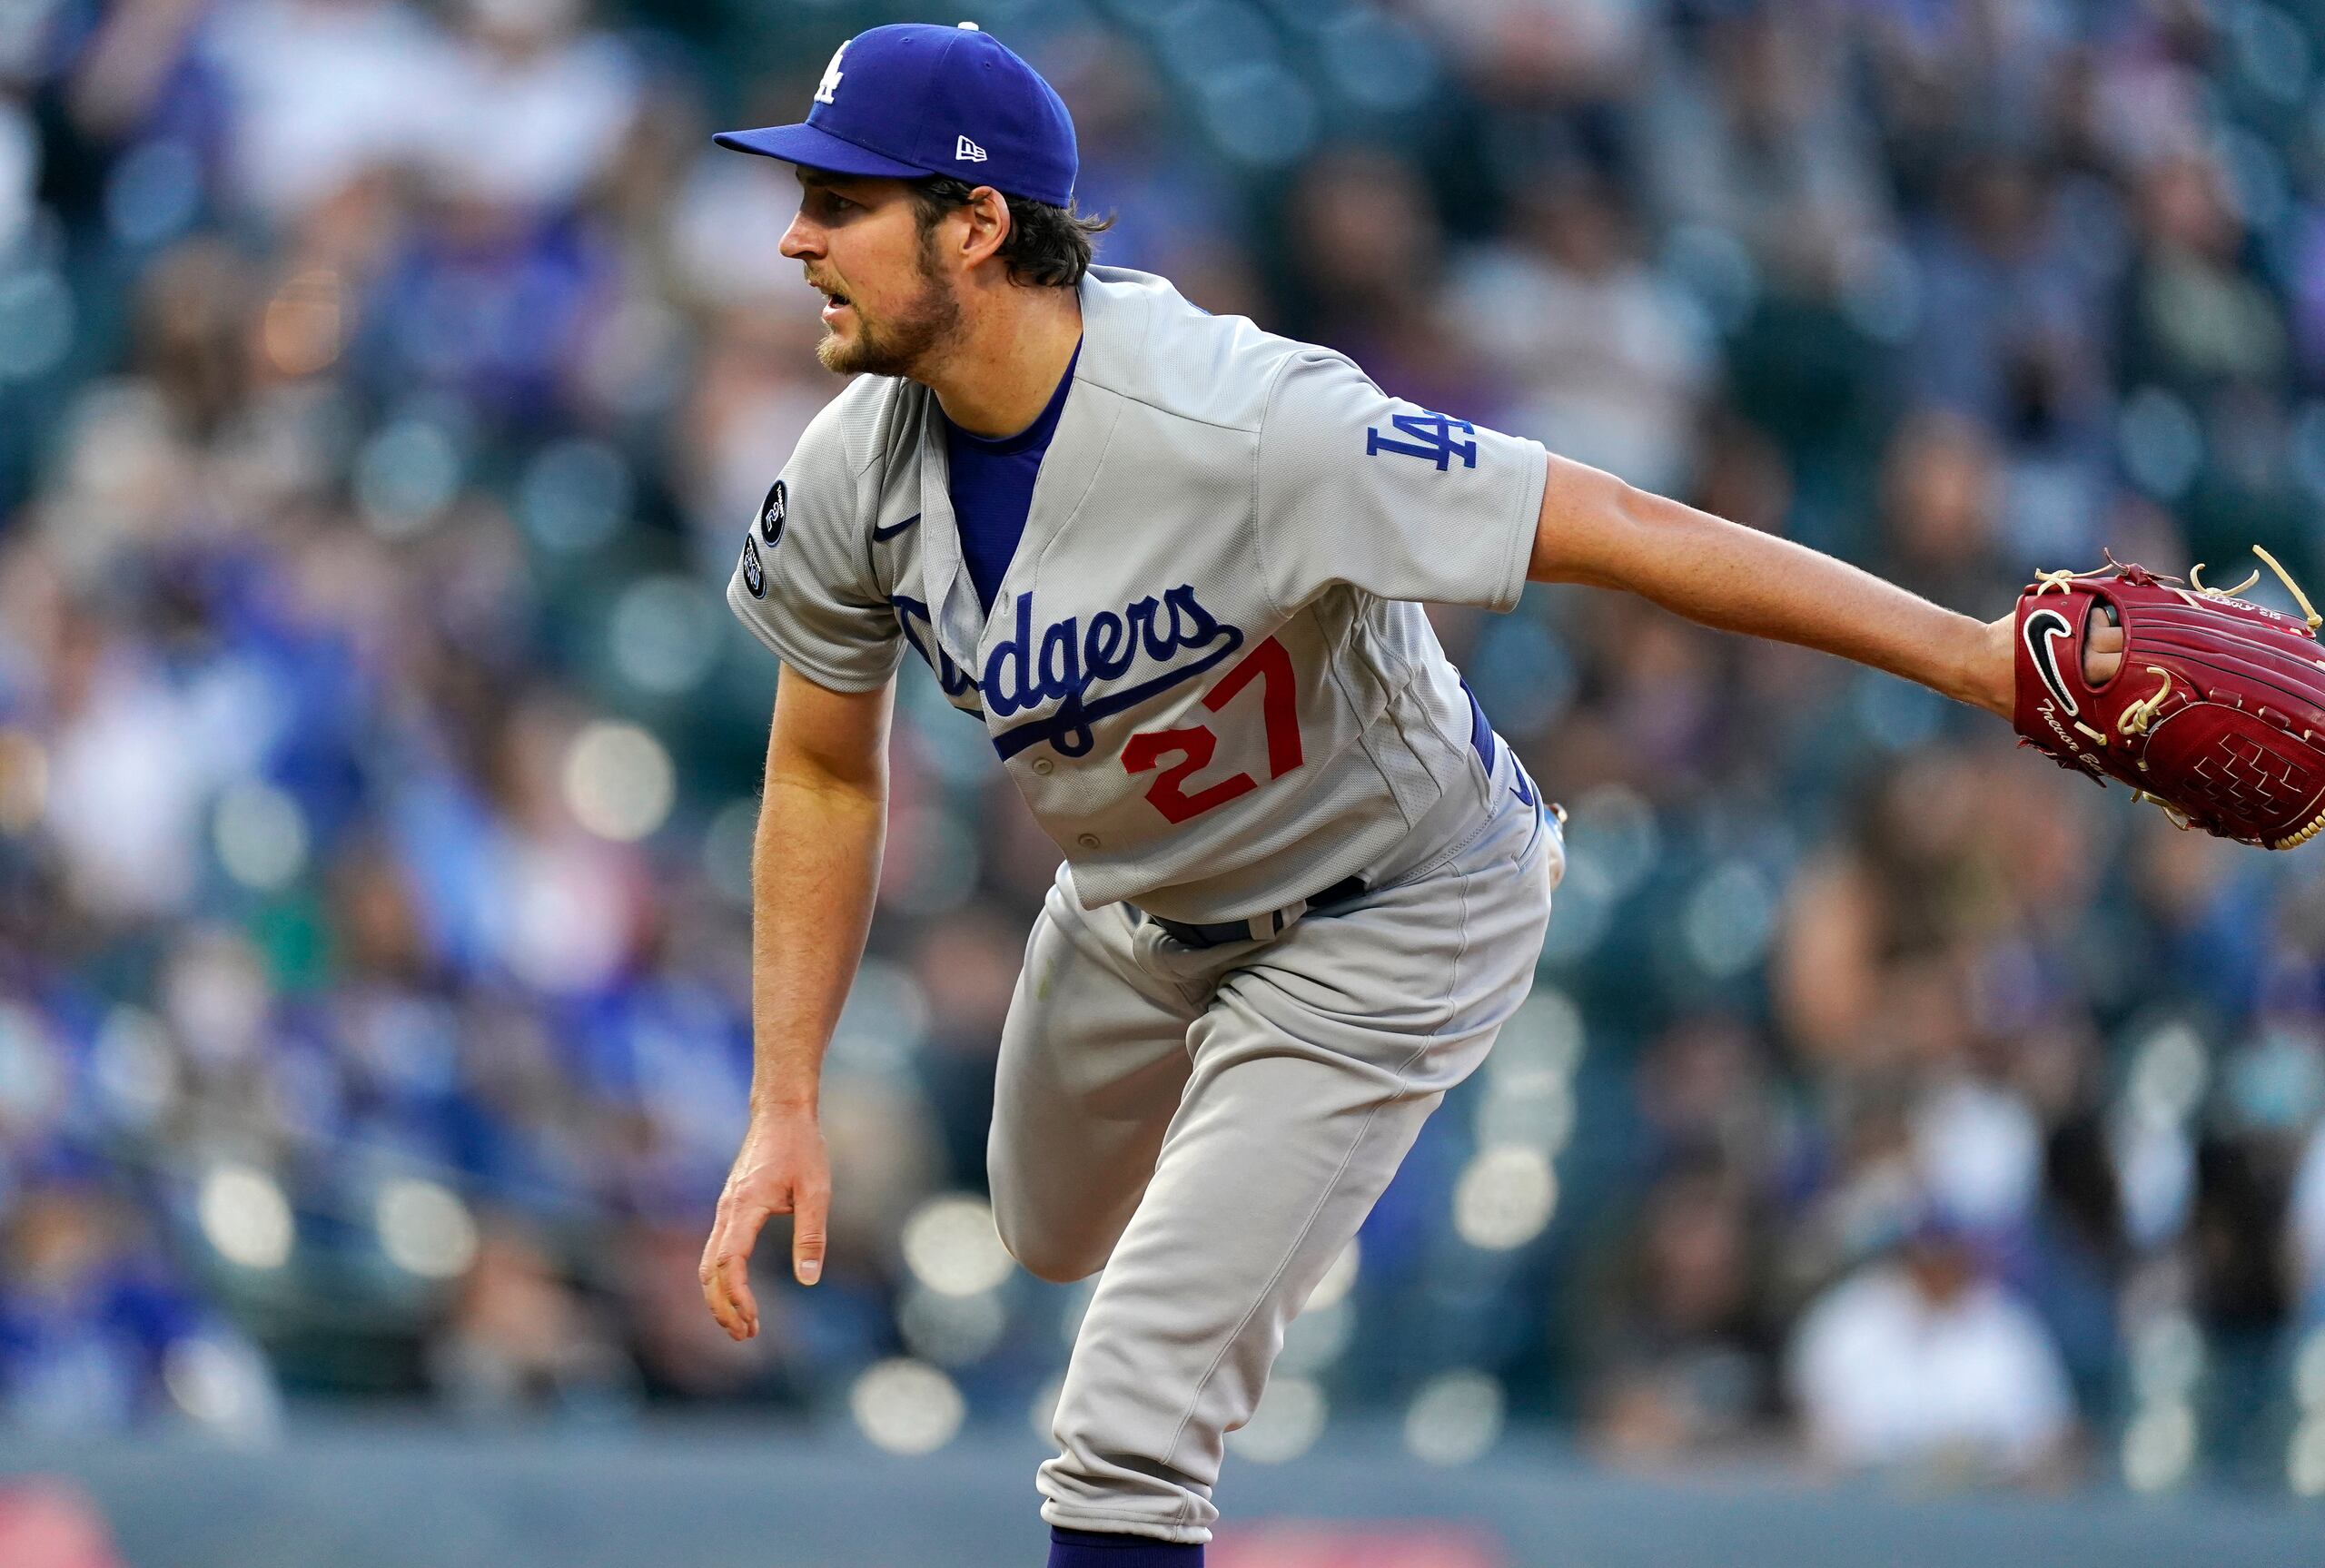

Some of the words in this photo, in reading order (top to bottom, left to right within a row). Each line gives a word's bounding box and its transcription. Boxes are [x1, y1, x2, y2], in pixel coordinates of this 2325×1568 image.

[1367, 409, 1477, 471] LA
[766, 501, 779, 533] 2
[1121, 635, 1303, 824] 27
[2036, 698, 2080, 752] Trevor
